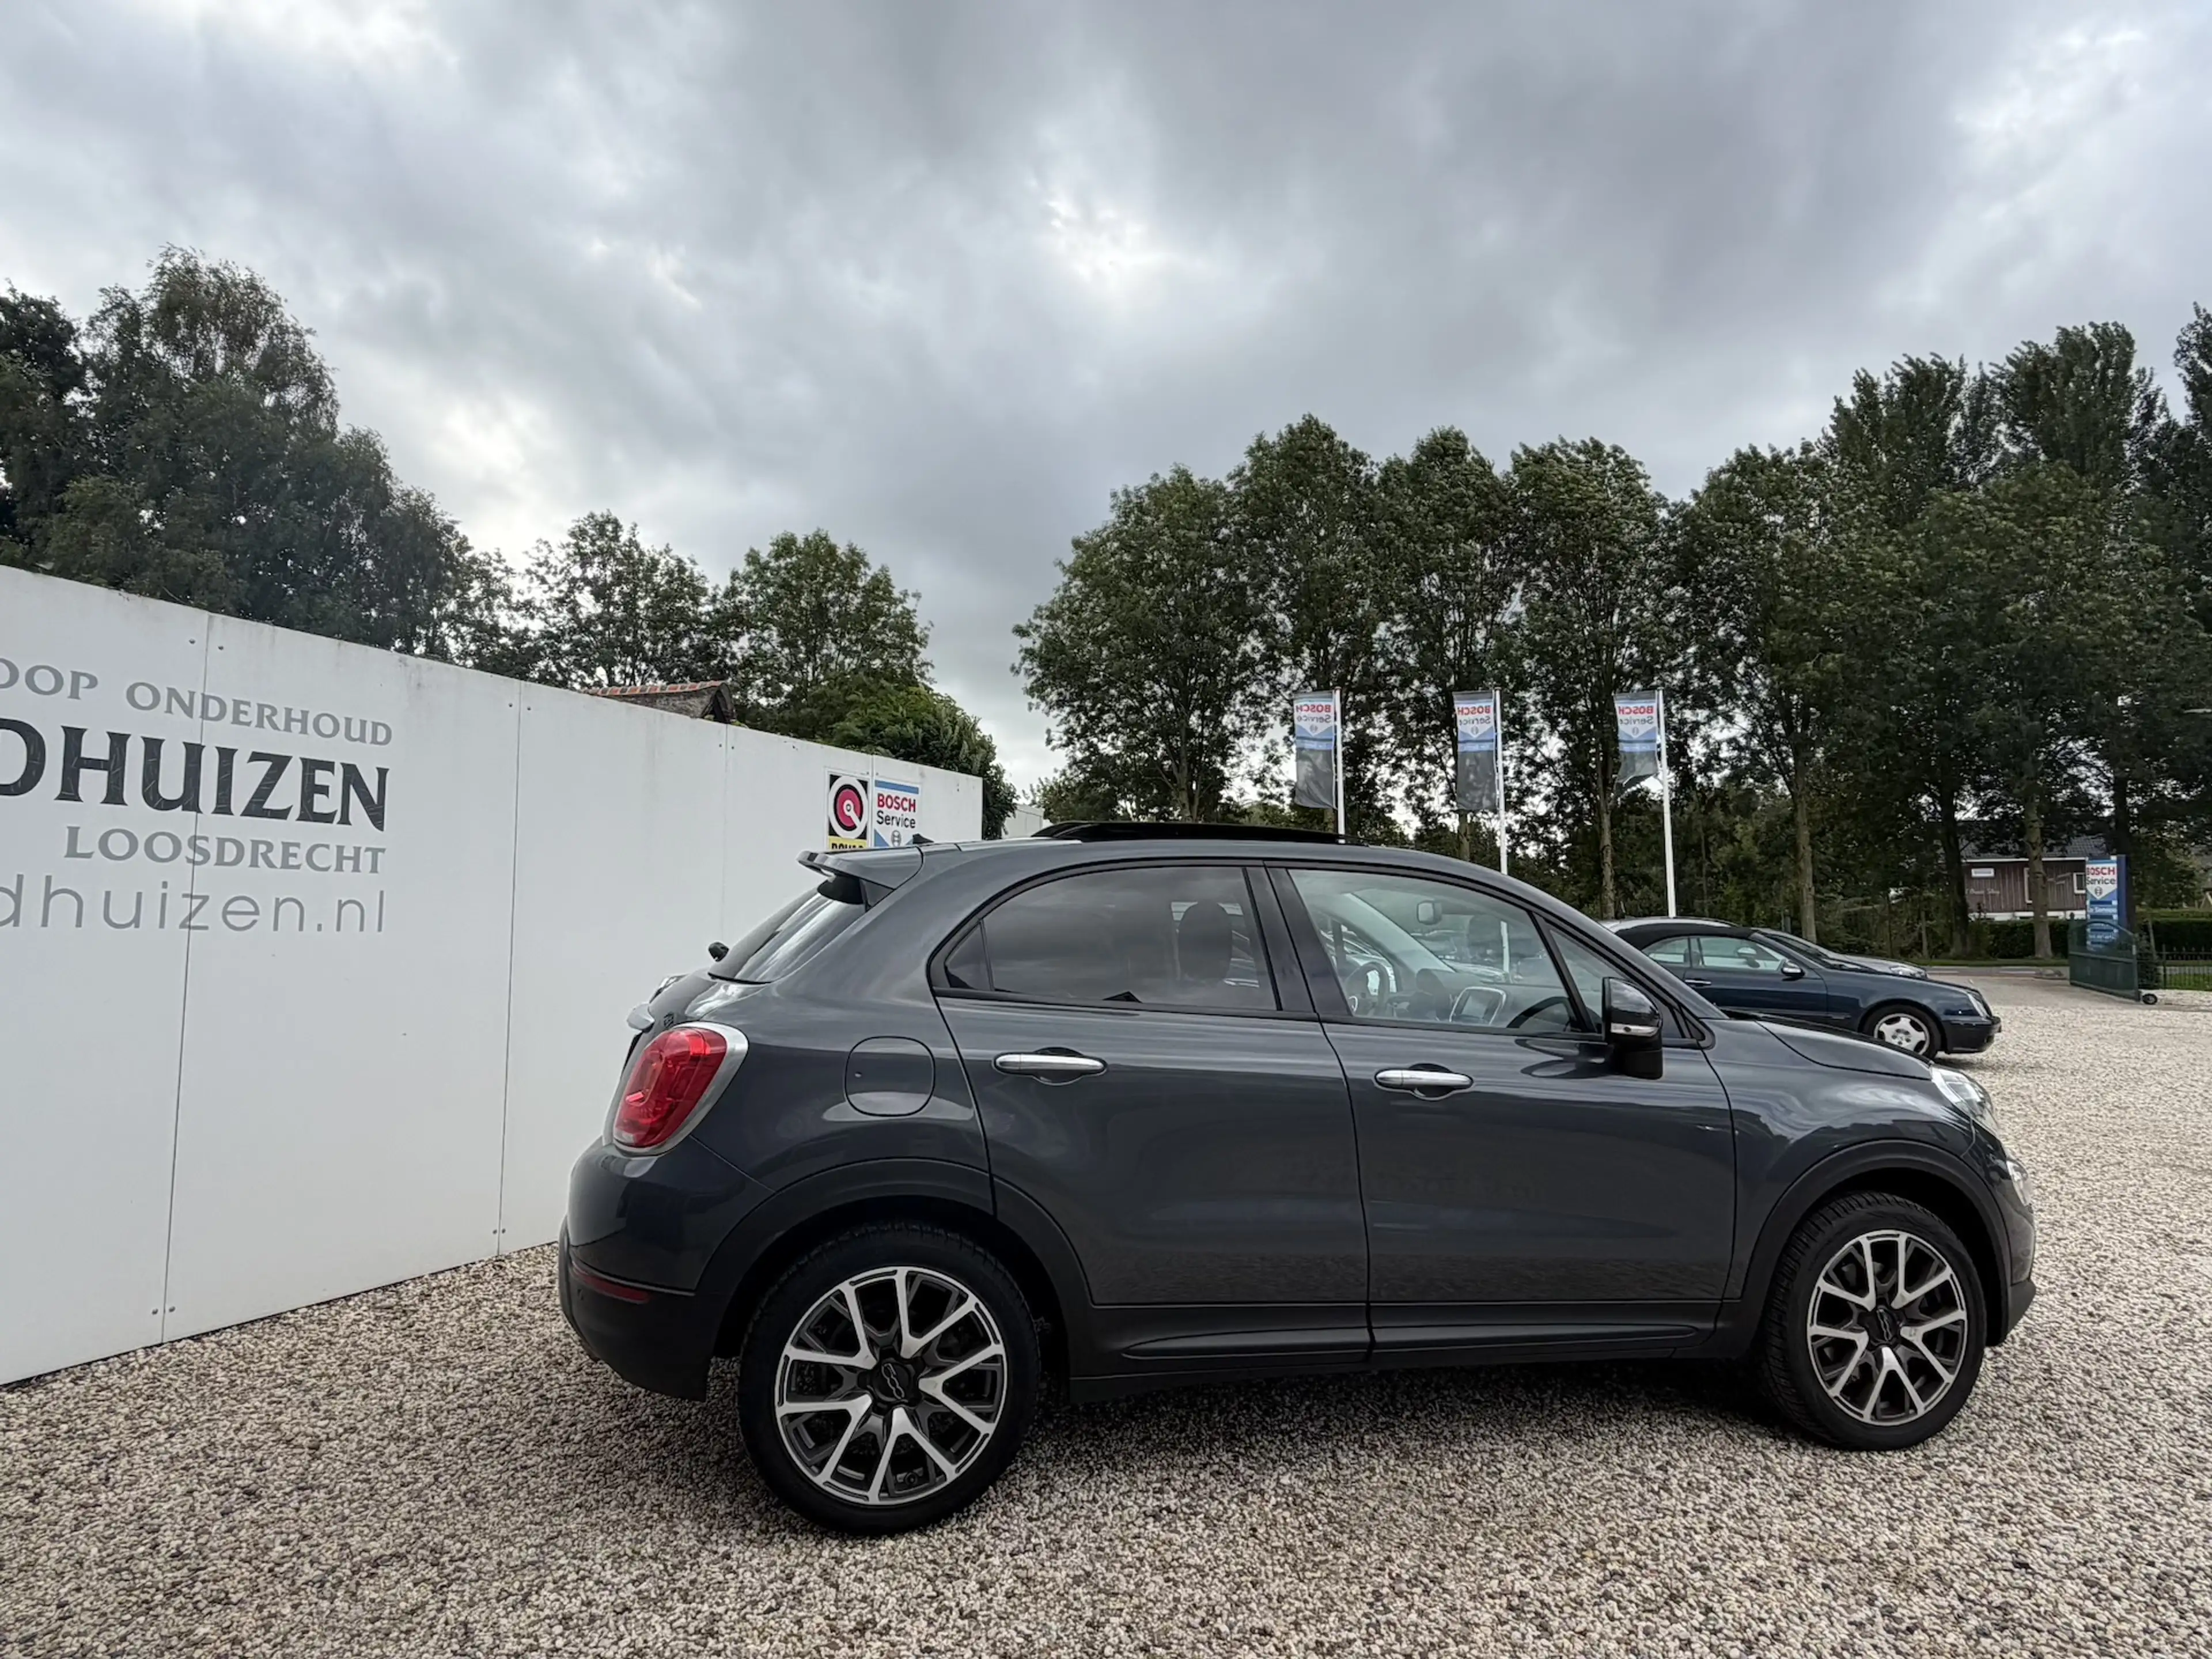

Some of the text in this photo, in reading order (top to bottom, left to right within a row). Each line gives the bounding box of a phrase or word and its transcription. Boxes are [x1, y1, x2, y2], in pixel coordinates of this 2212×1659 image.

[126, 682, 392, 746] ONDERHOUD
[876, 810, 916, 829] Service
[877, 793, 916, 813] BOSCH
[64, 825, 386, 874] LOOSDRECHT
[0, 873, 385, 933] dhuizen.nl
